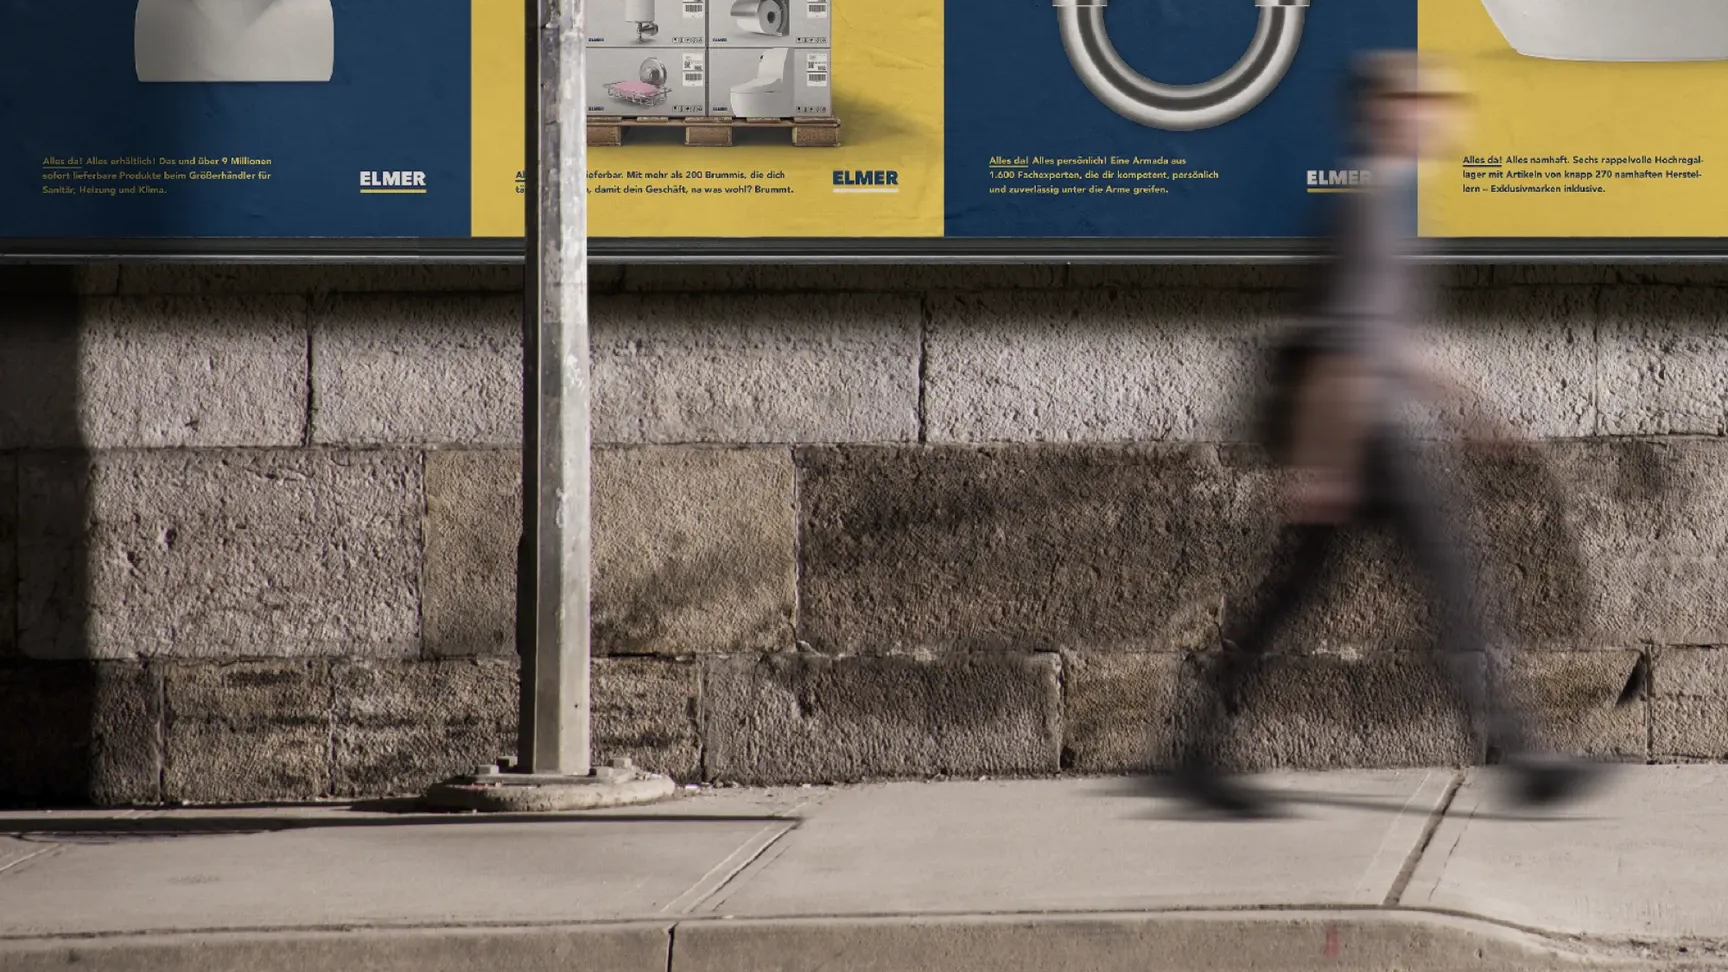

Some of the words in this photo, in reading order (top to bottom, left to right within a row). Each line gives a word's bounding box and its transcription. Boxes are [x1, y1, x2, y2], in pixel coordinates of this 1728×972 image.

[989, 156, 1011, 165] Alles
[1032, 156, 1054, 164] Alles
[1056, 156, 1106, 166] persönlich!
[1110, 156, 1130, 164] Eine
[1132, 156, 1169, 164] Armada
[1463, 156, 1485, 164] Alles
[1530, 155, 1569, 163] namhaft.
[1573, 156, 1598, 164] Sechs
[1602, 156, 1652, 165] rappelvolle
[1654, 155, 1703, 166] Hochregal-
[360, 171, 427, 186] ELMER
[671, 170, 683, 178] als
[704, 171, 746, 179] Brummis,
[766, 171, 785, 179] dich
[833, 170, 899, 185] ELMER
[1018, 171, 1082, 180] Fachexperten,
[1085, 170, 1099, 179] die
[1102, 170, 1114, 179] dir
[1118, 170, 1169, 180] kompetent,
[1172, 170, 1219, 180] persönlich
[1463, 170, 1486, 180] lager
[1489, 170, 1503, 178] mit
[1506, 170, 1542, 178] Artikeln
[1564, 170, 1593, 180] knapp
[1596, 170, 1612, 178] 270
[1615, 170, 1662, 178] namhaften
[1666, 170, 1701, 178] Herstel-
[595, 185, 621, 193] damit
[623, 185, 643, 193] dein
[645, 185, 688, 194] Geschäft,
[725, 185, 752, 193] wohl?
[755, 185, 794, 193] Brummt.
[989, 185, 1007, 193] und
[1009, 185, 1060, 195] zuverlässig
[1062, 186, 1086, 194] unter
[1088, 185, 1103, 193] die
[1105, 184, 1130, 194] Arme
[1133, 185, 1168, 195] greifen.
[1463, 184, 1480, 193] lern
[1490, 184, 1561, 193] Exklusivmarken
